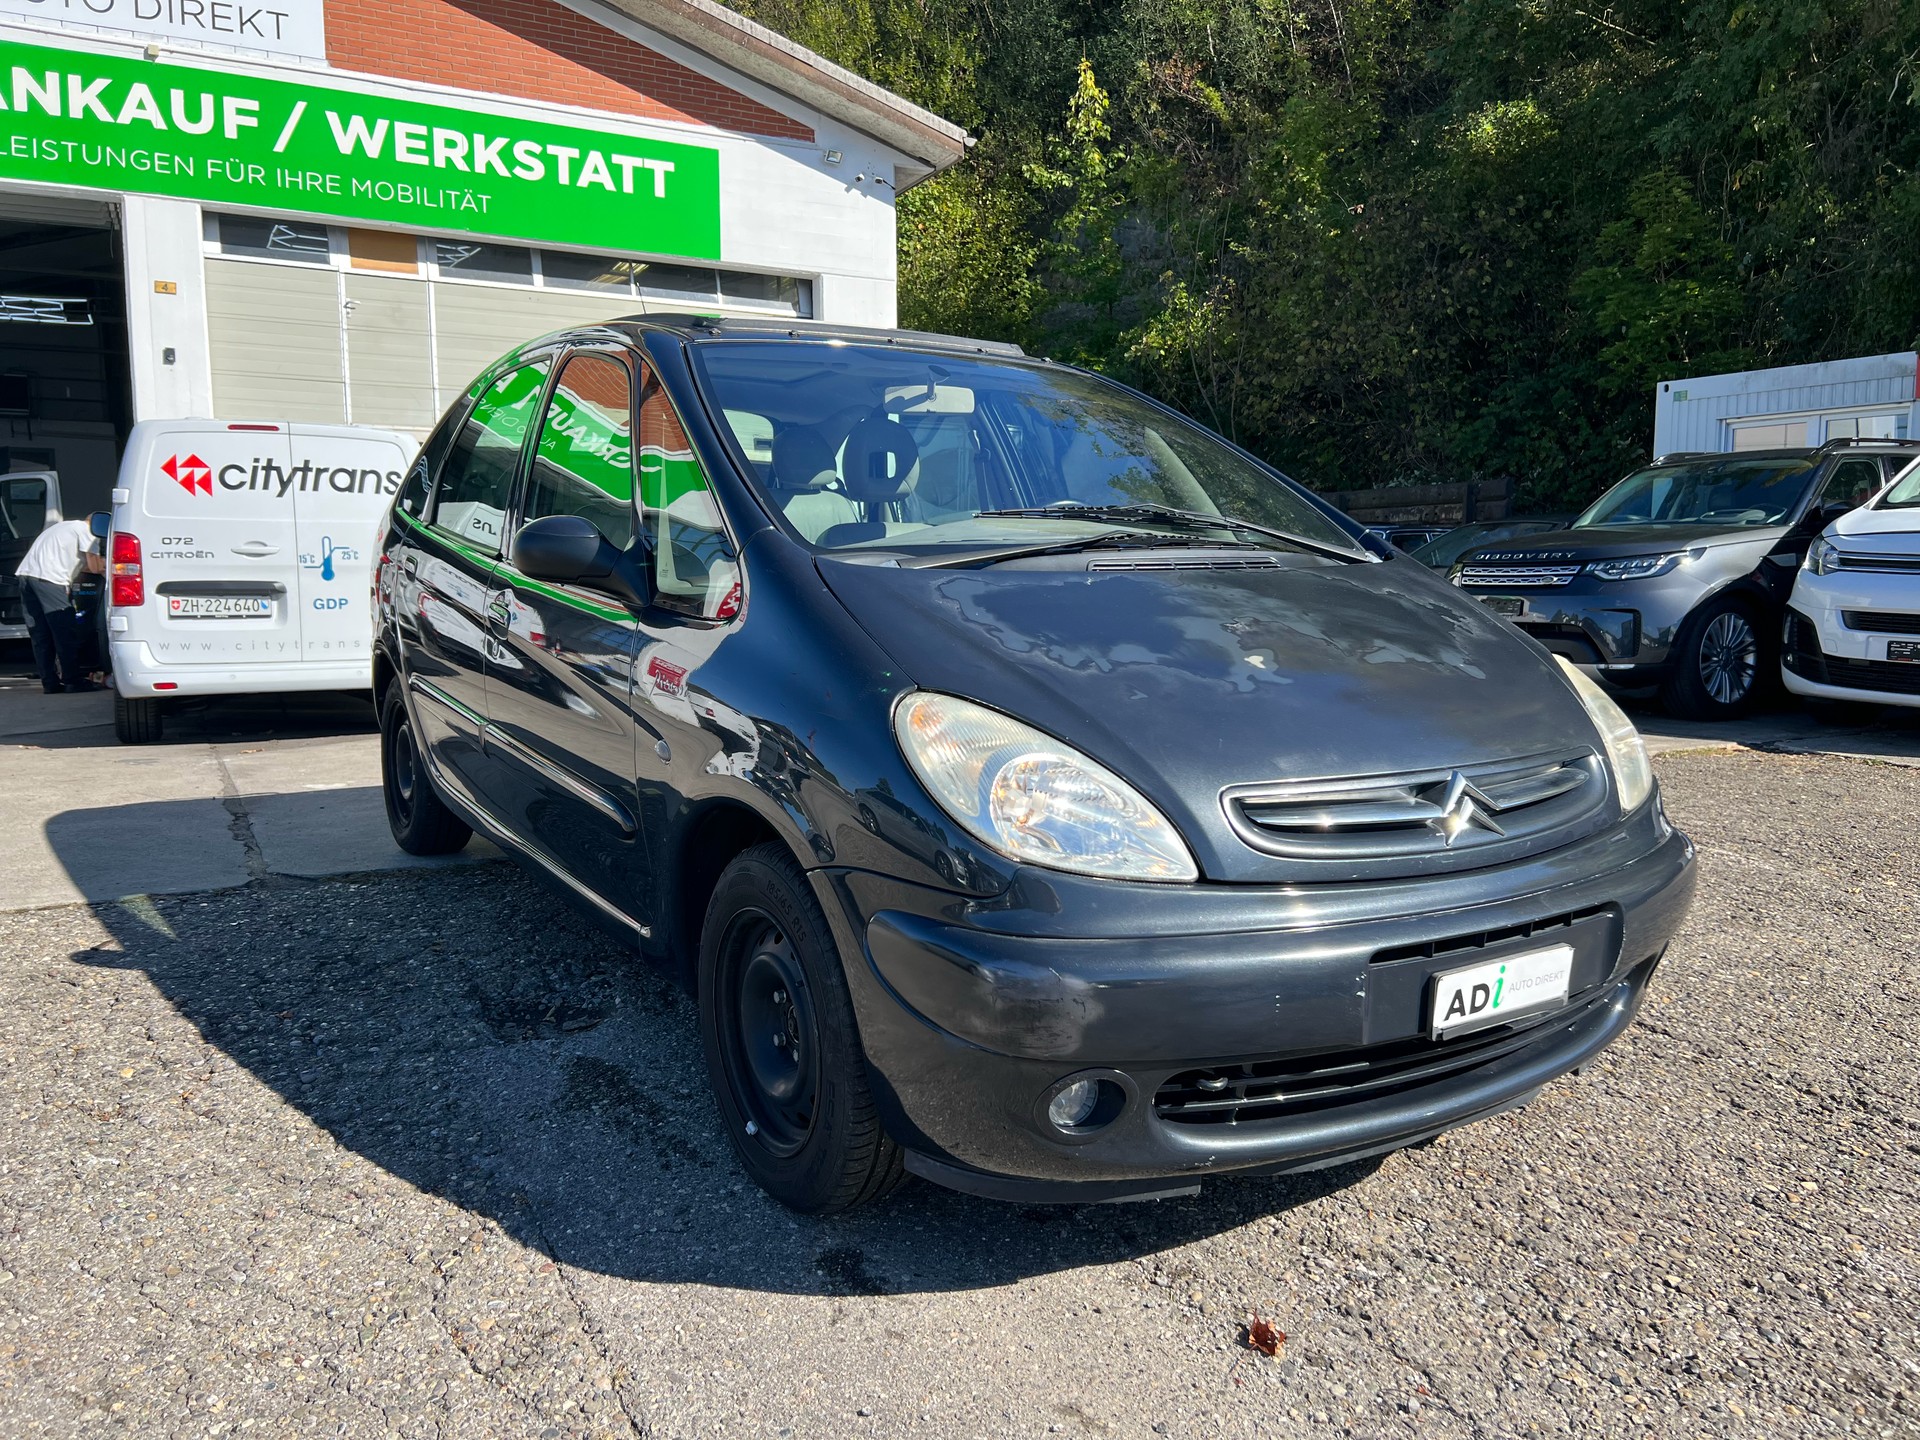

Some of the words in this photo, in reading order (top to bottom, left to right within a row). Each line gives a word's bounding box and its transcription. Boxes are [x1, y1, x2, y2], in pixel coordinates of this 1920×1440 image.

[0, 66, 260, 140] NKAUF
[325, 110, 675, 198] WERKSTATT
[207, 158, 265, 186] FÜR
[277, 169, 341, 195] IHRE
[352, 180, 492, 214] MOBILITÄT
[218, 457, 402, 498] citytrans
[161, 537, 194, 545] 072
[1475, 551, 1577, 561] DISCOVERY
[313, 598, 349, 610] GDP
[1508, 978, 1532, 993] AUTO
[1535, 970, 1565, 987] DIREKT
